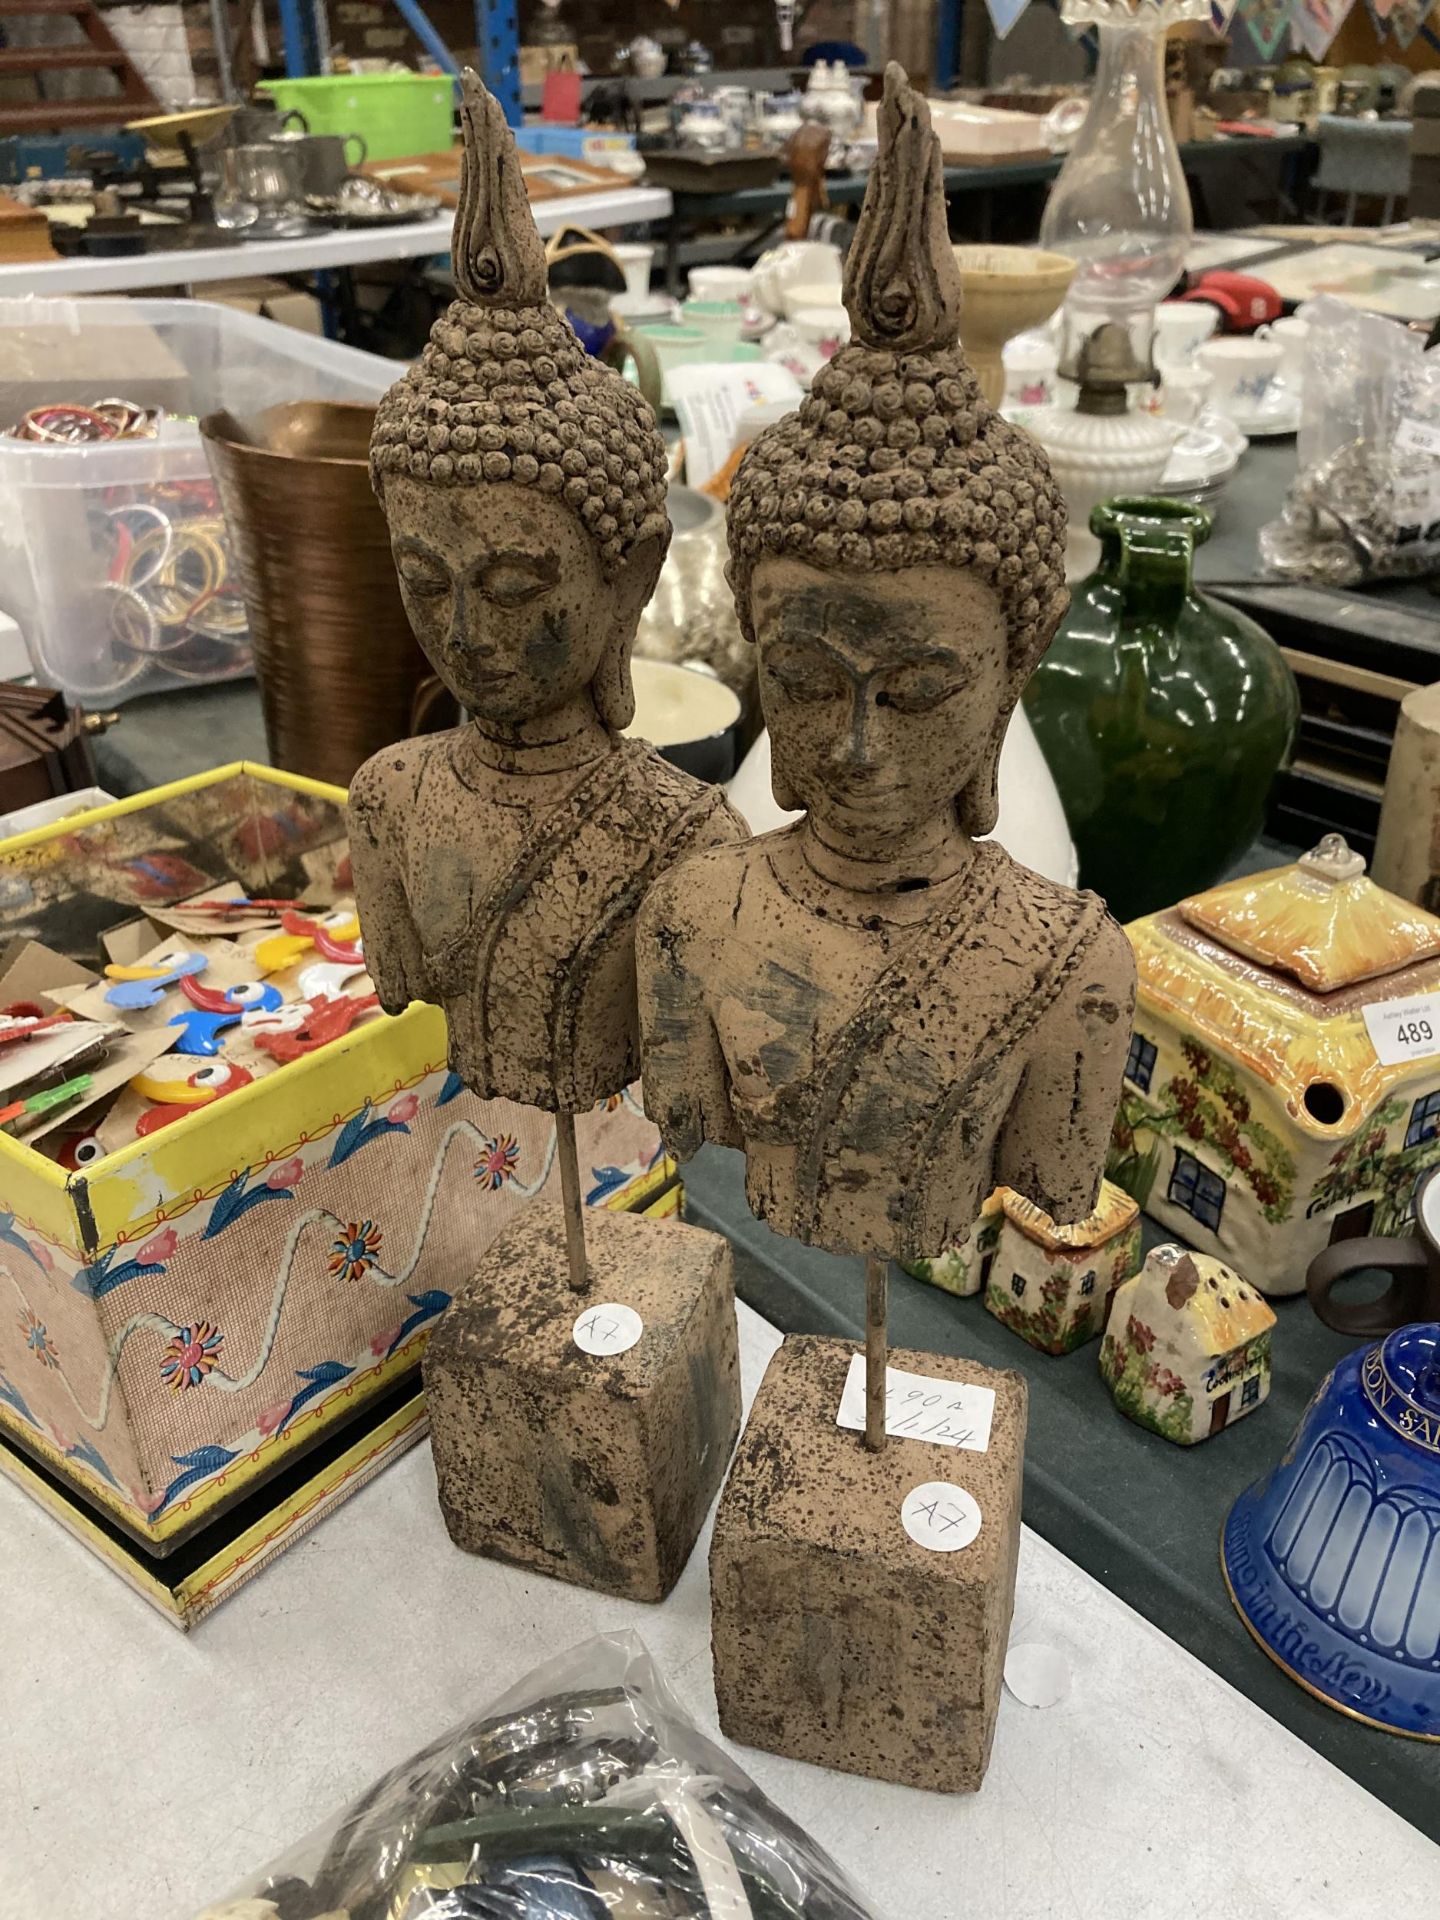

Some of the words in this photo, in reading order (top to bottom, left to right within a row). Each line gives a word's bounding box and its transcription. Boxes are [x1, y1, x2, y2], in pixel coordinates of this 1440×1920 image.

[1397, 1019, 1434, 1045] 489
[577, 1314, 620, 1341] A7
[911, 1500, 967, 1533] A7
[1248, 1580, 1279, 1628] in
[1270, 1611, 1321, 1672] the
